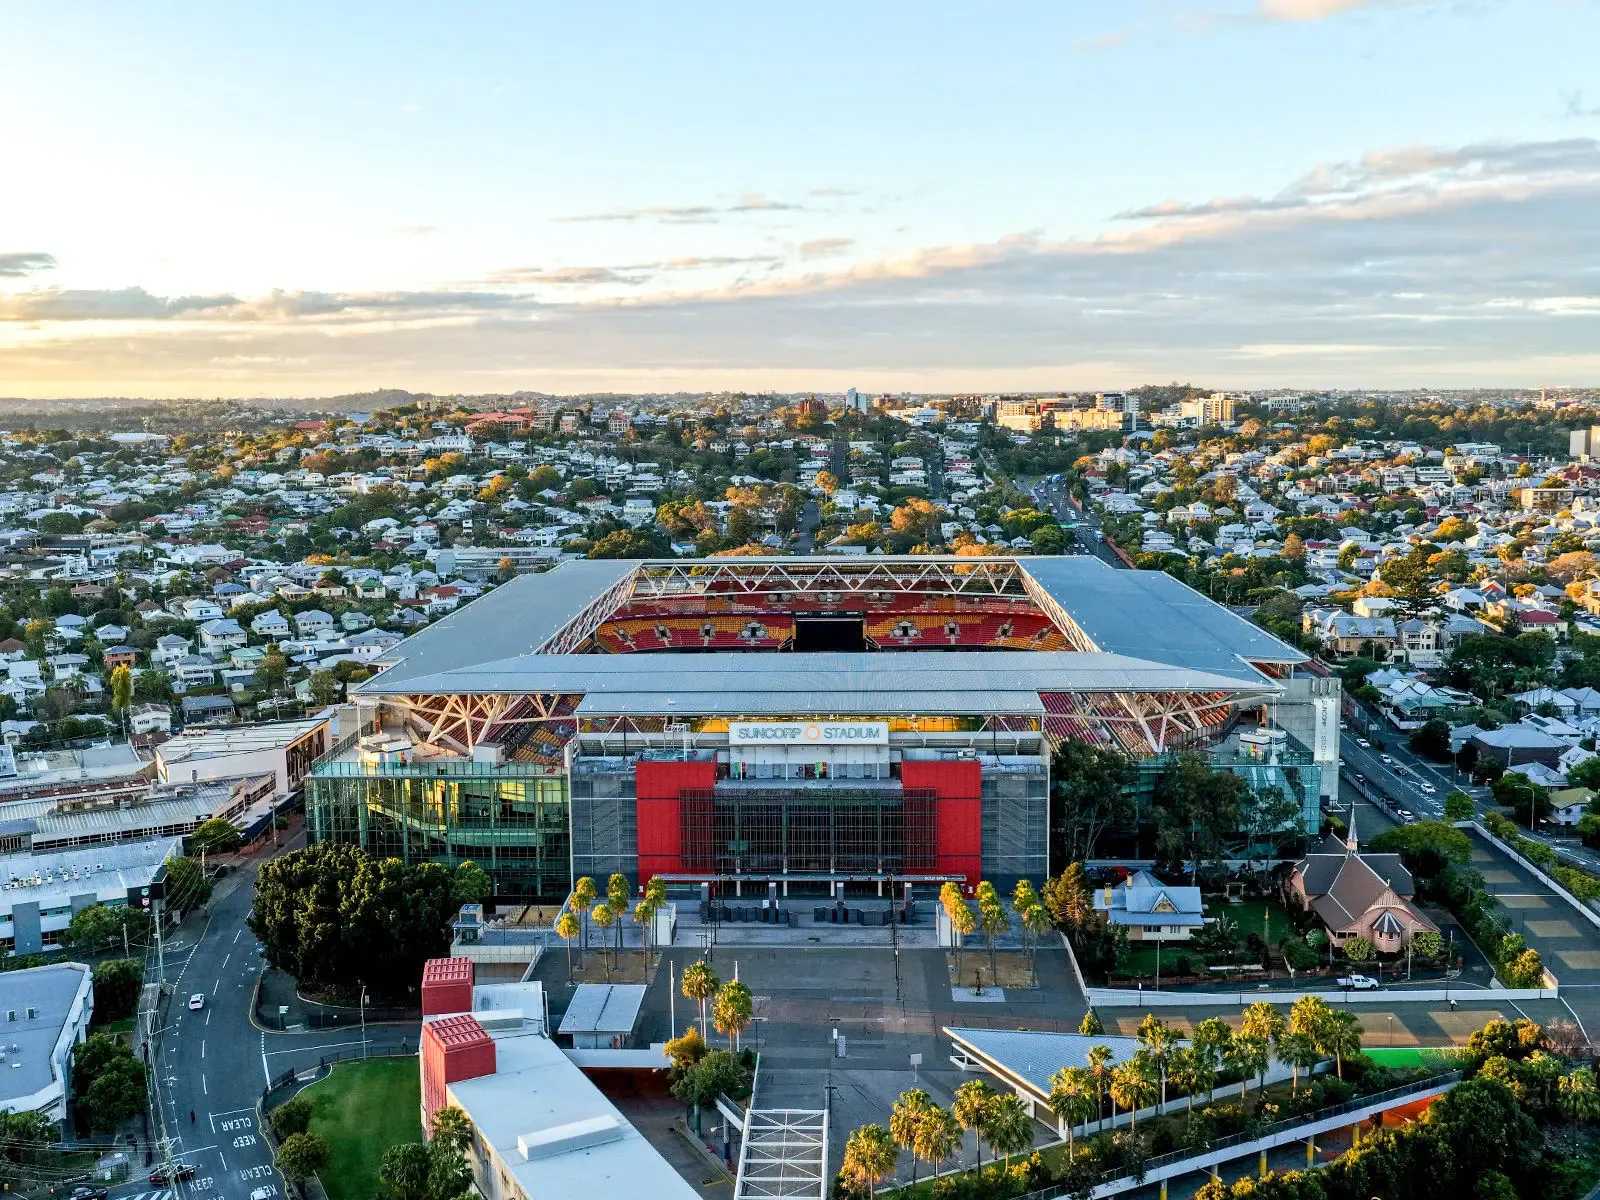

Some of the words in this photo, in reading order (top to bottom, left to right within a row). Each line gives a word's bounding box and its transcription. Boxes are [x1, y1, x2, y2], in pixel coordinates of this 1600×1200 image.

[738, 727, 802, 739] SUNCORP
[823, 727, 880, 739] STADIUM
[221, 1117, 252, 1131] CLEAR
[233, 1134, 257, 1148] KEEP
[240, 1164, 272, 1181] CLEAR
[188, 1177, 214, 1192] KEEP
